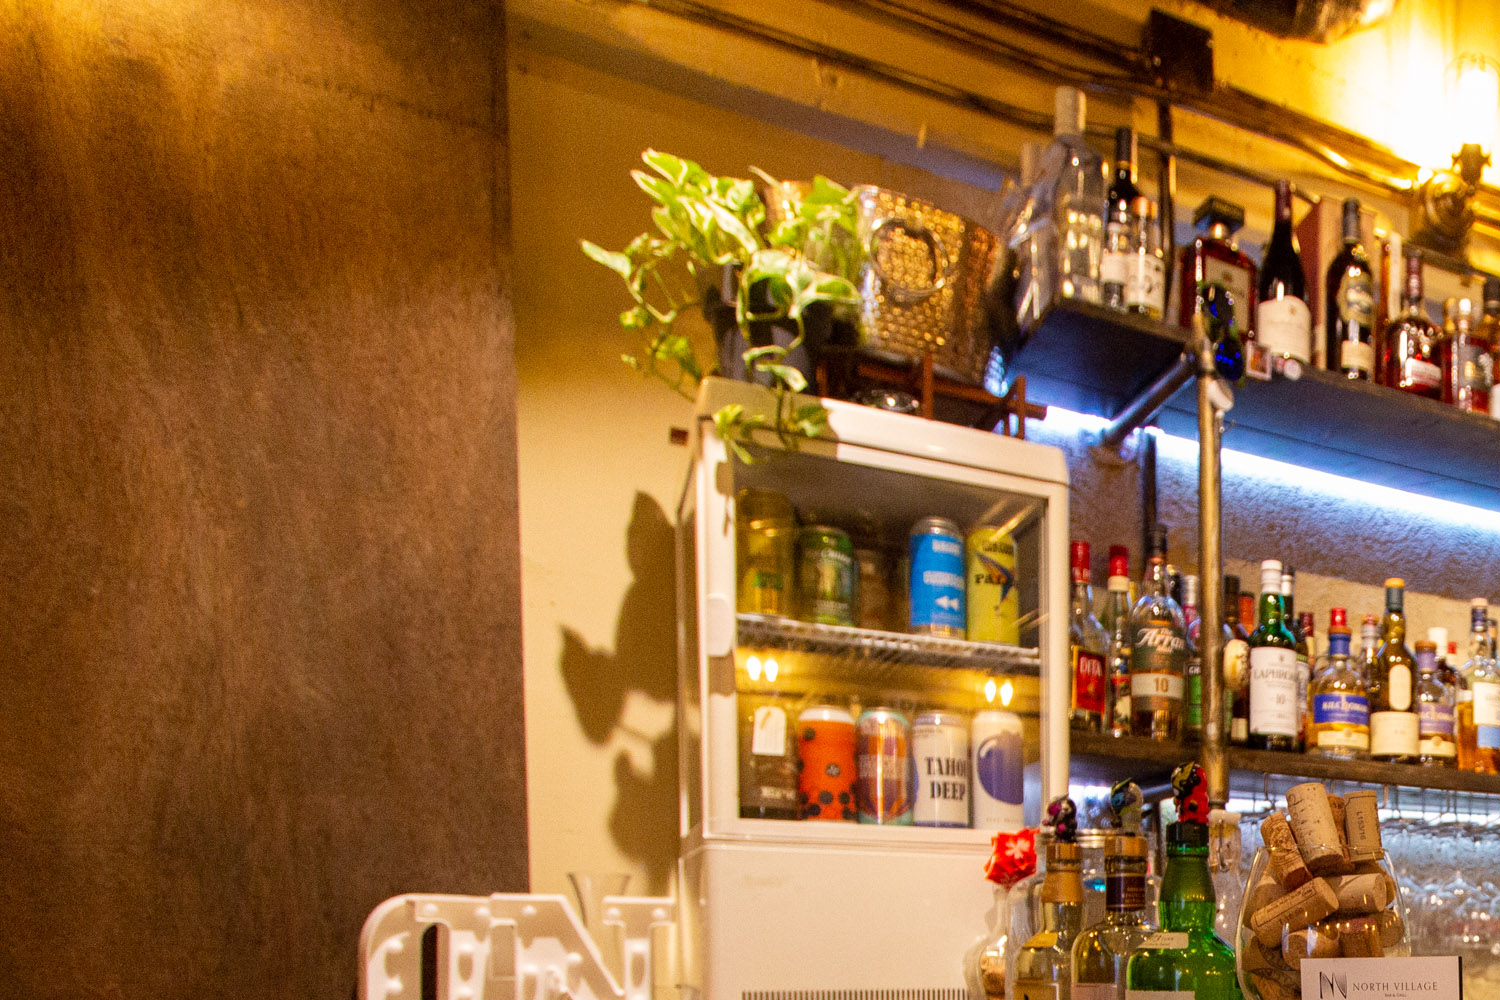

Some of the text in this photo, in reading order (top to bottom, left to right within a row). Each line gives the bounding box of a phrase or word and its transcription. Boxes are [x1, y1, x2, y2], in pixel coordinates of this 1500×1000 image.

[1154, 677, 1169, 693] 10
[930, 781, 966, 801] DEEP
[1352, 981, 1438, 992] NORTH VILLAGE
